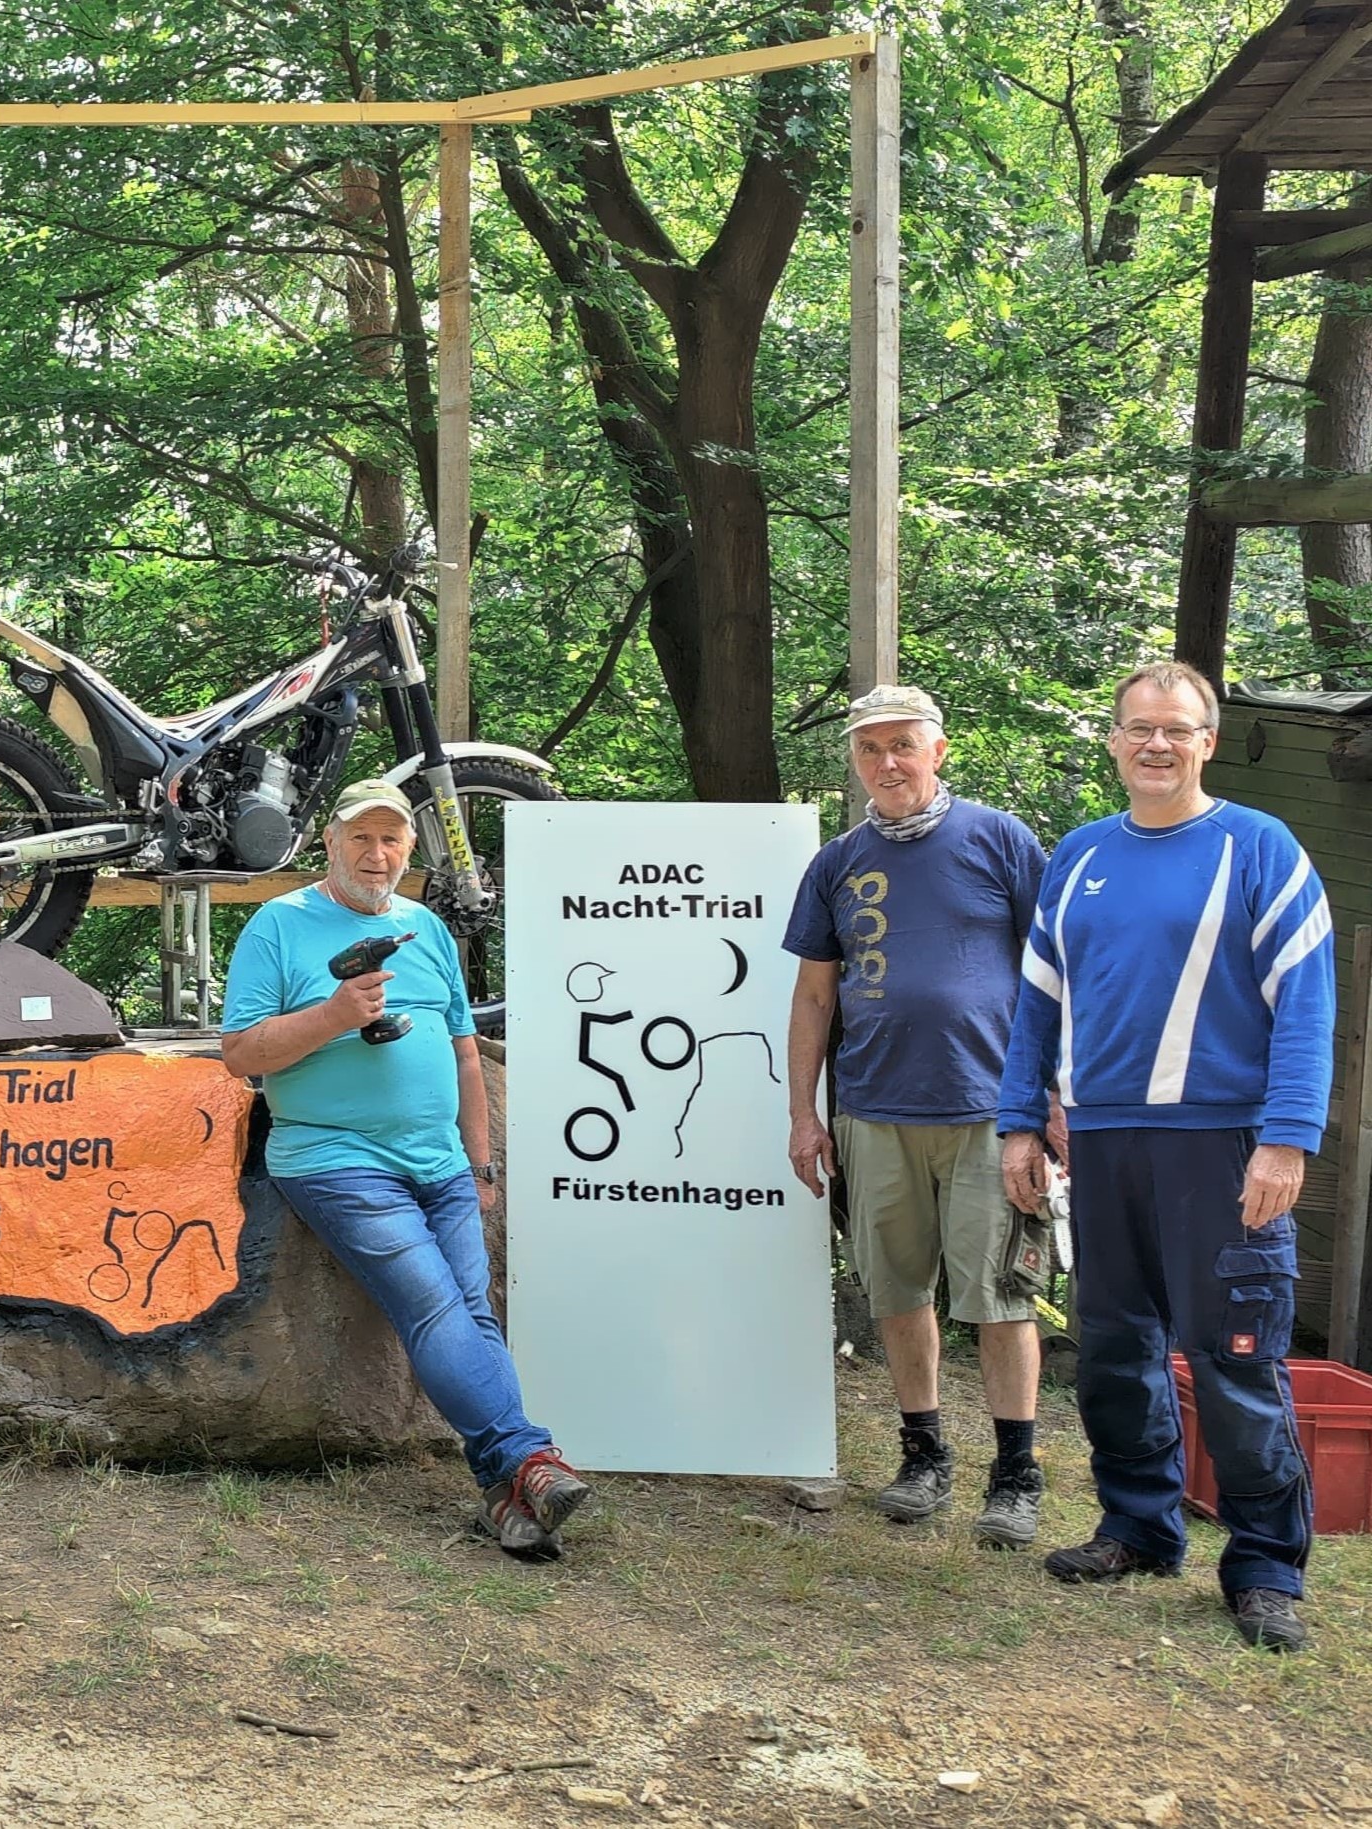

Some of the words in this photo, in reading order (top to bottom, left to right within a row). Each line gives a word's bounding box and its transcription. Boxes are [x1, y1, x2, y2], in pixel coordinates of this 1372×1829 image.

[618, 864, 705, 885] ADAC
[562, 894, 763, 920] Nacht-Trial
[552, 1176, 786, 1211] Fürstenhagen
